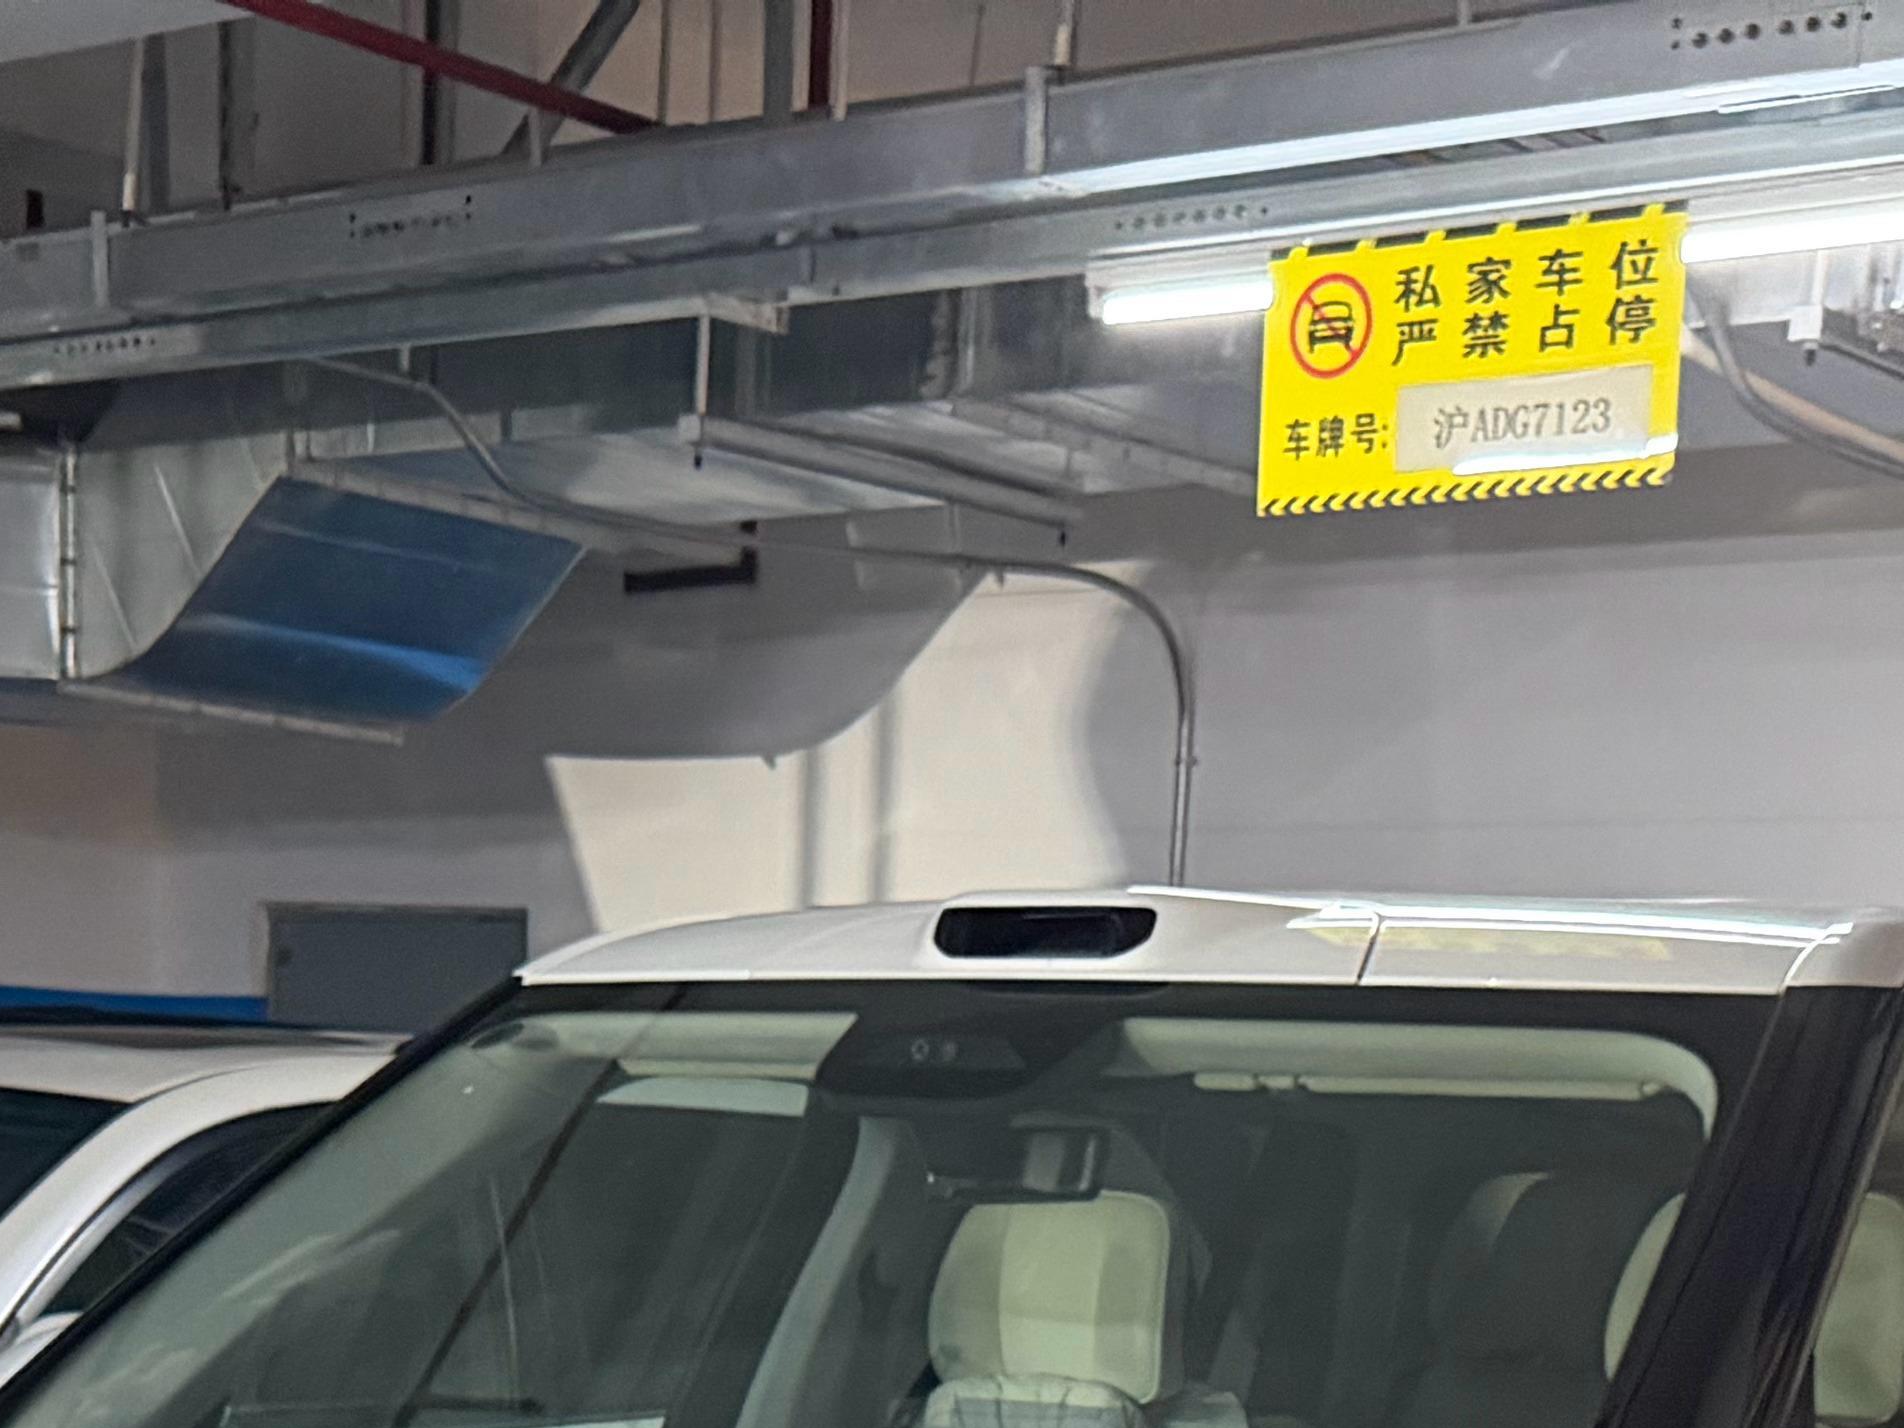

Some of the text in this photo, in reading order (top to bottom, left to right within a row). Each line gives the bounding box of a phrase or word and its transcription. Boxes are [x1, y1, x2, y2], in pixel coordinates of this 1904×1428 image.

[1393, 240, 1662, 312] 私家车位
[1391, 296, 1658, 367] 严禁占停
[1433, 397, 1613, 450] 沪ADG7123
